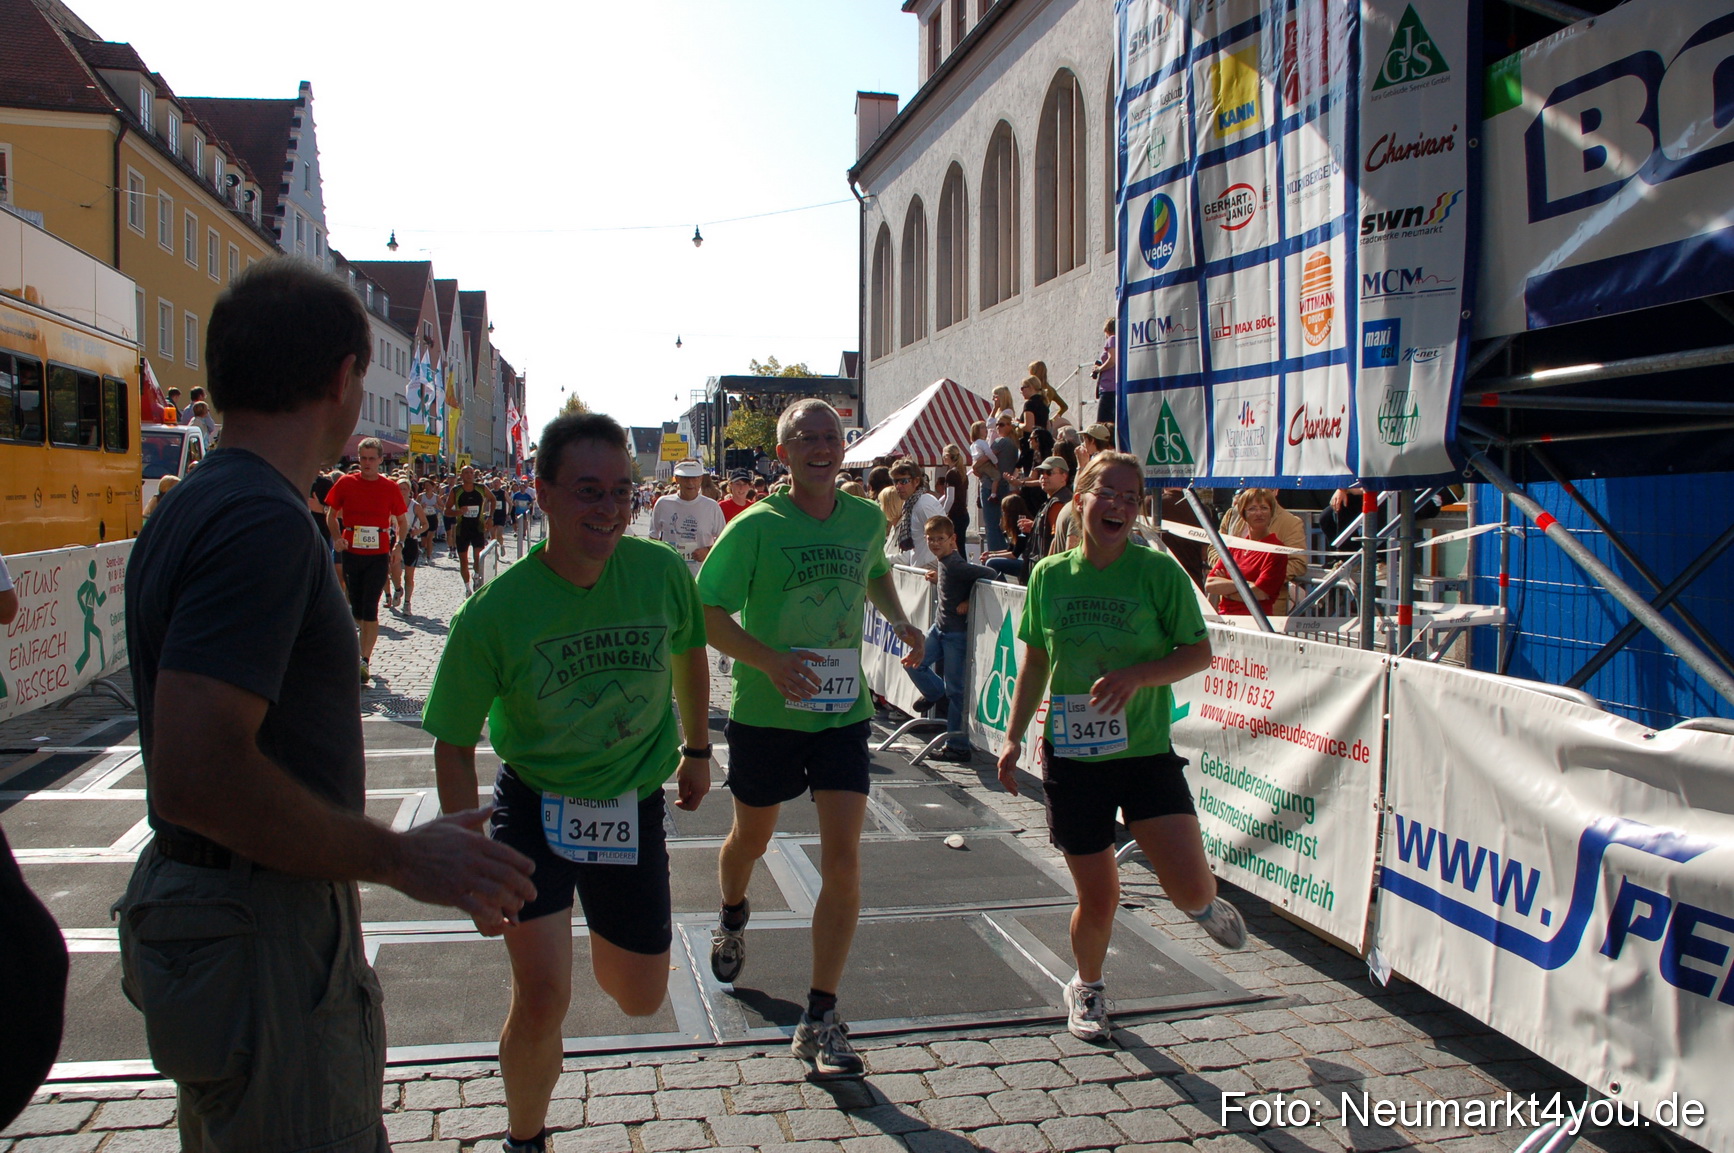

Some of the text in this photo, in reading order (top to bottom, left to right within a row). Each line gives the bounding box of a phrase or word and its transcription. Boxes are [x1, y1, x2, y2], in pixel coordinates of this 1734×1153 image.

[1383, 87, 1408, 99] Gebäude
[1409, 82, 1430, 92] Service
[1431, 75, 1451, 86] GmbH
[1218, 100, 1255, 131] KANN
[1364, 124, 1458, 173] Charivari
[1204, 192, 1248, 216] GERHART
[1226, 203, 1254, 222] JANIG
[1361, 205, 1425, 236] swn
[1360, 225, 1444, 246] stadtwerke neumarkt
[1145, 241, 1173, 262] vedes
[1363, 267, 1424, 296] MCM
[1131, 315, 1172, 346] MCM
[1235, 321, 1254, 335] MAX
[1364, 327, 1392, 348] maxi
[1381, 345, 1395, 359] dsl
[1225, 425, 1266, 448] NEUMARKTER
[1378, 416, 1421, 444] SCHAU
[362, 535, 376, 543] 685
[801, 550, 862, 565] ATEMLOS
[33, 566, 61, 597] UNS
[797, 563, 862, 583] DETTINGEN
[1066, 600, 1127, 614] ATEMLOS
[8, 600, 58, 639] LÄUFTS
[1061, 612, 1125, 628] DETTINGEN
[561, 630, 650, 661] ATEMLOS
[556, 650, 652, 686] DETTINGEN
[1210, 653, 1269, 681] ervice-Line:
[16, 664, 69, 706] BESSER
[818, 677, 855, 695] 477
[1204, 675, 1275, 710] 0 91 81 / 63 52
[1067, 701, 1086, 713] Lisa
[1072, 719, 1121, 740] 3476
[1201, 702, 1370, 764] www.jura-gebaeudeservice.de
[1201, 751, 1316, 825] Gebäudereinigung
[545, 810, 551, 822] B
[1199, 786, 1318, 860] Hausmeisterdienst
[568, 818, 631, 843] 3478
[599, 851, 636, 860] PFLEIDERER
